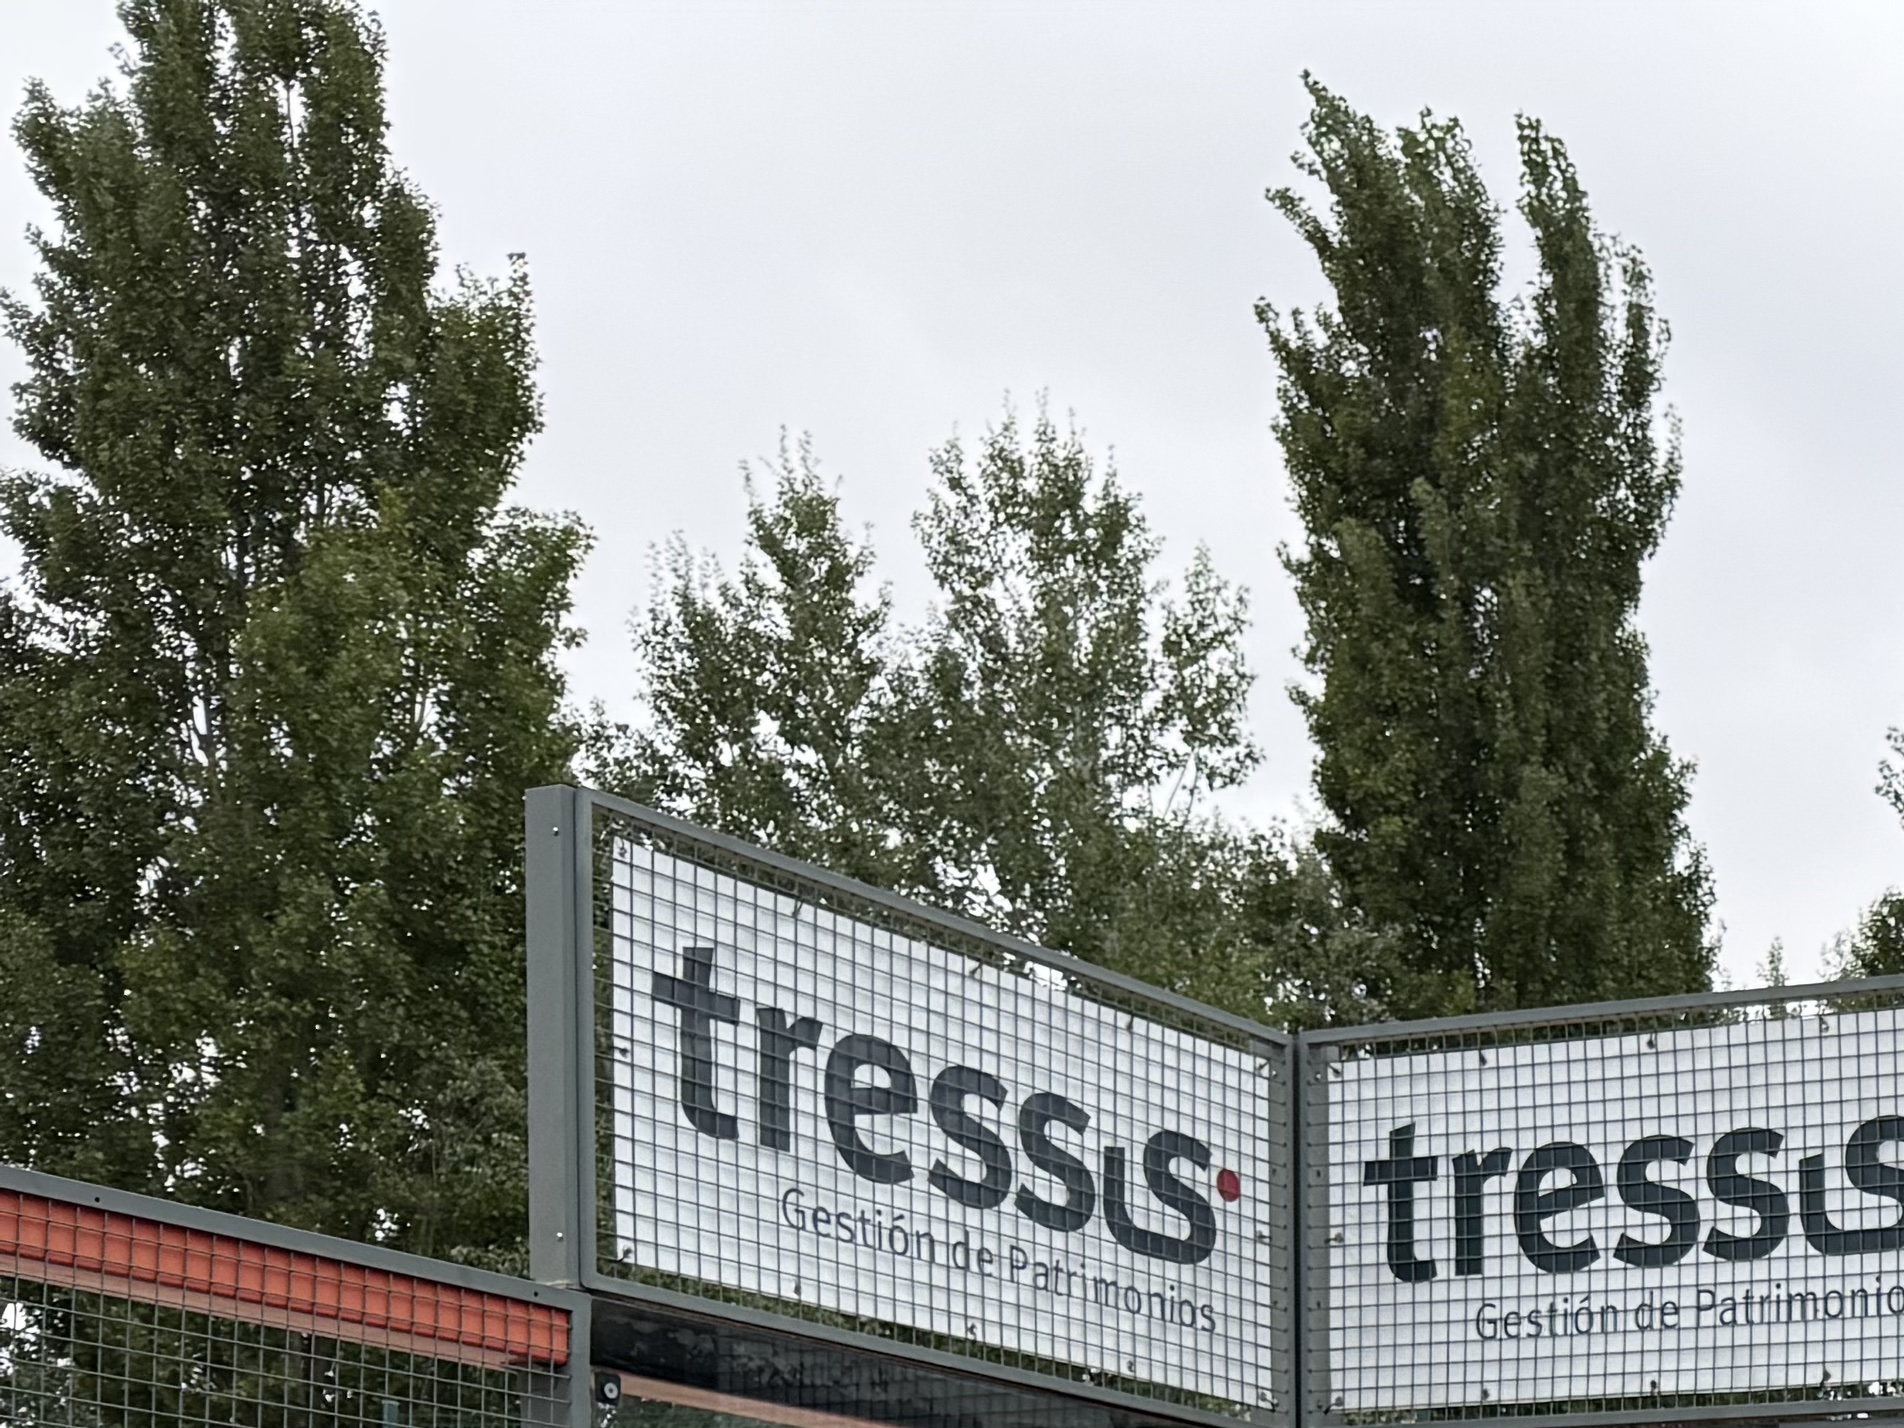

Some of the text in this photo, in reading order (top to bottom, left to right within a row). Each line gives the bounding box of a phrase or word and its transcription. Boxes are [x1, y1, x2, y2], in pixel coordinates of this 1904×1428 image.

[651, 947, 1240, 1265] tressis
[781, 1187, 1217, 1333] Gestión de Patrimonios
[1476, 1292, 1618, 1342] Gestión
[1635, 1292, 1678, 1331] de
